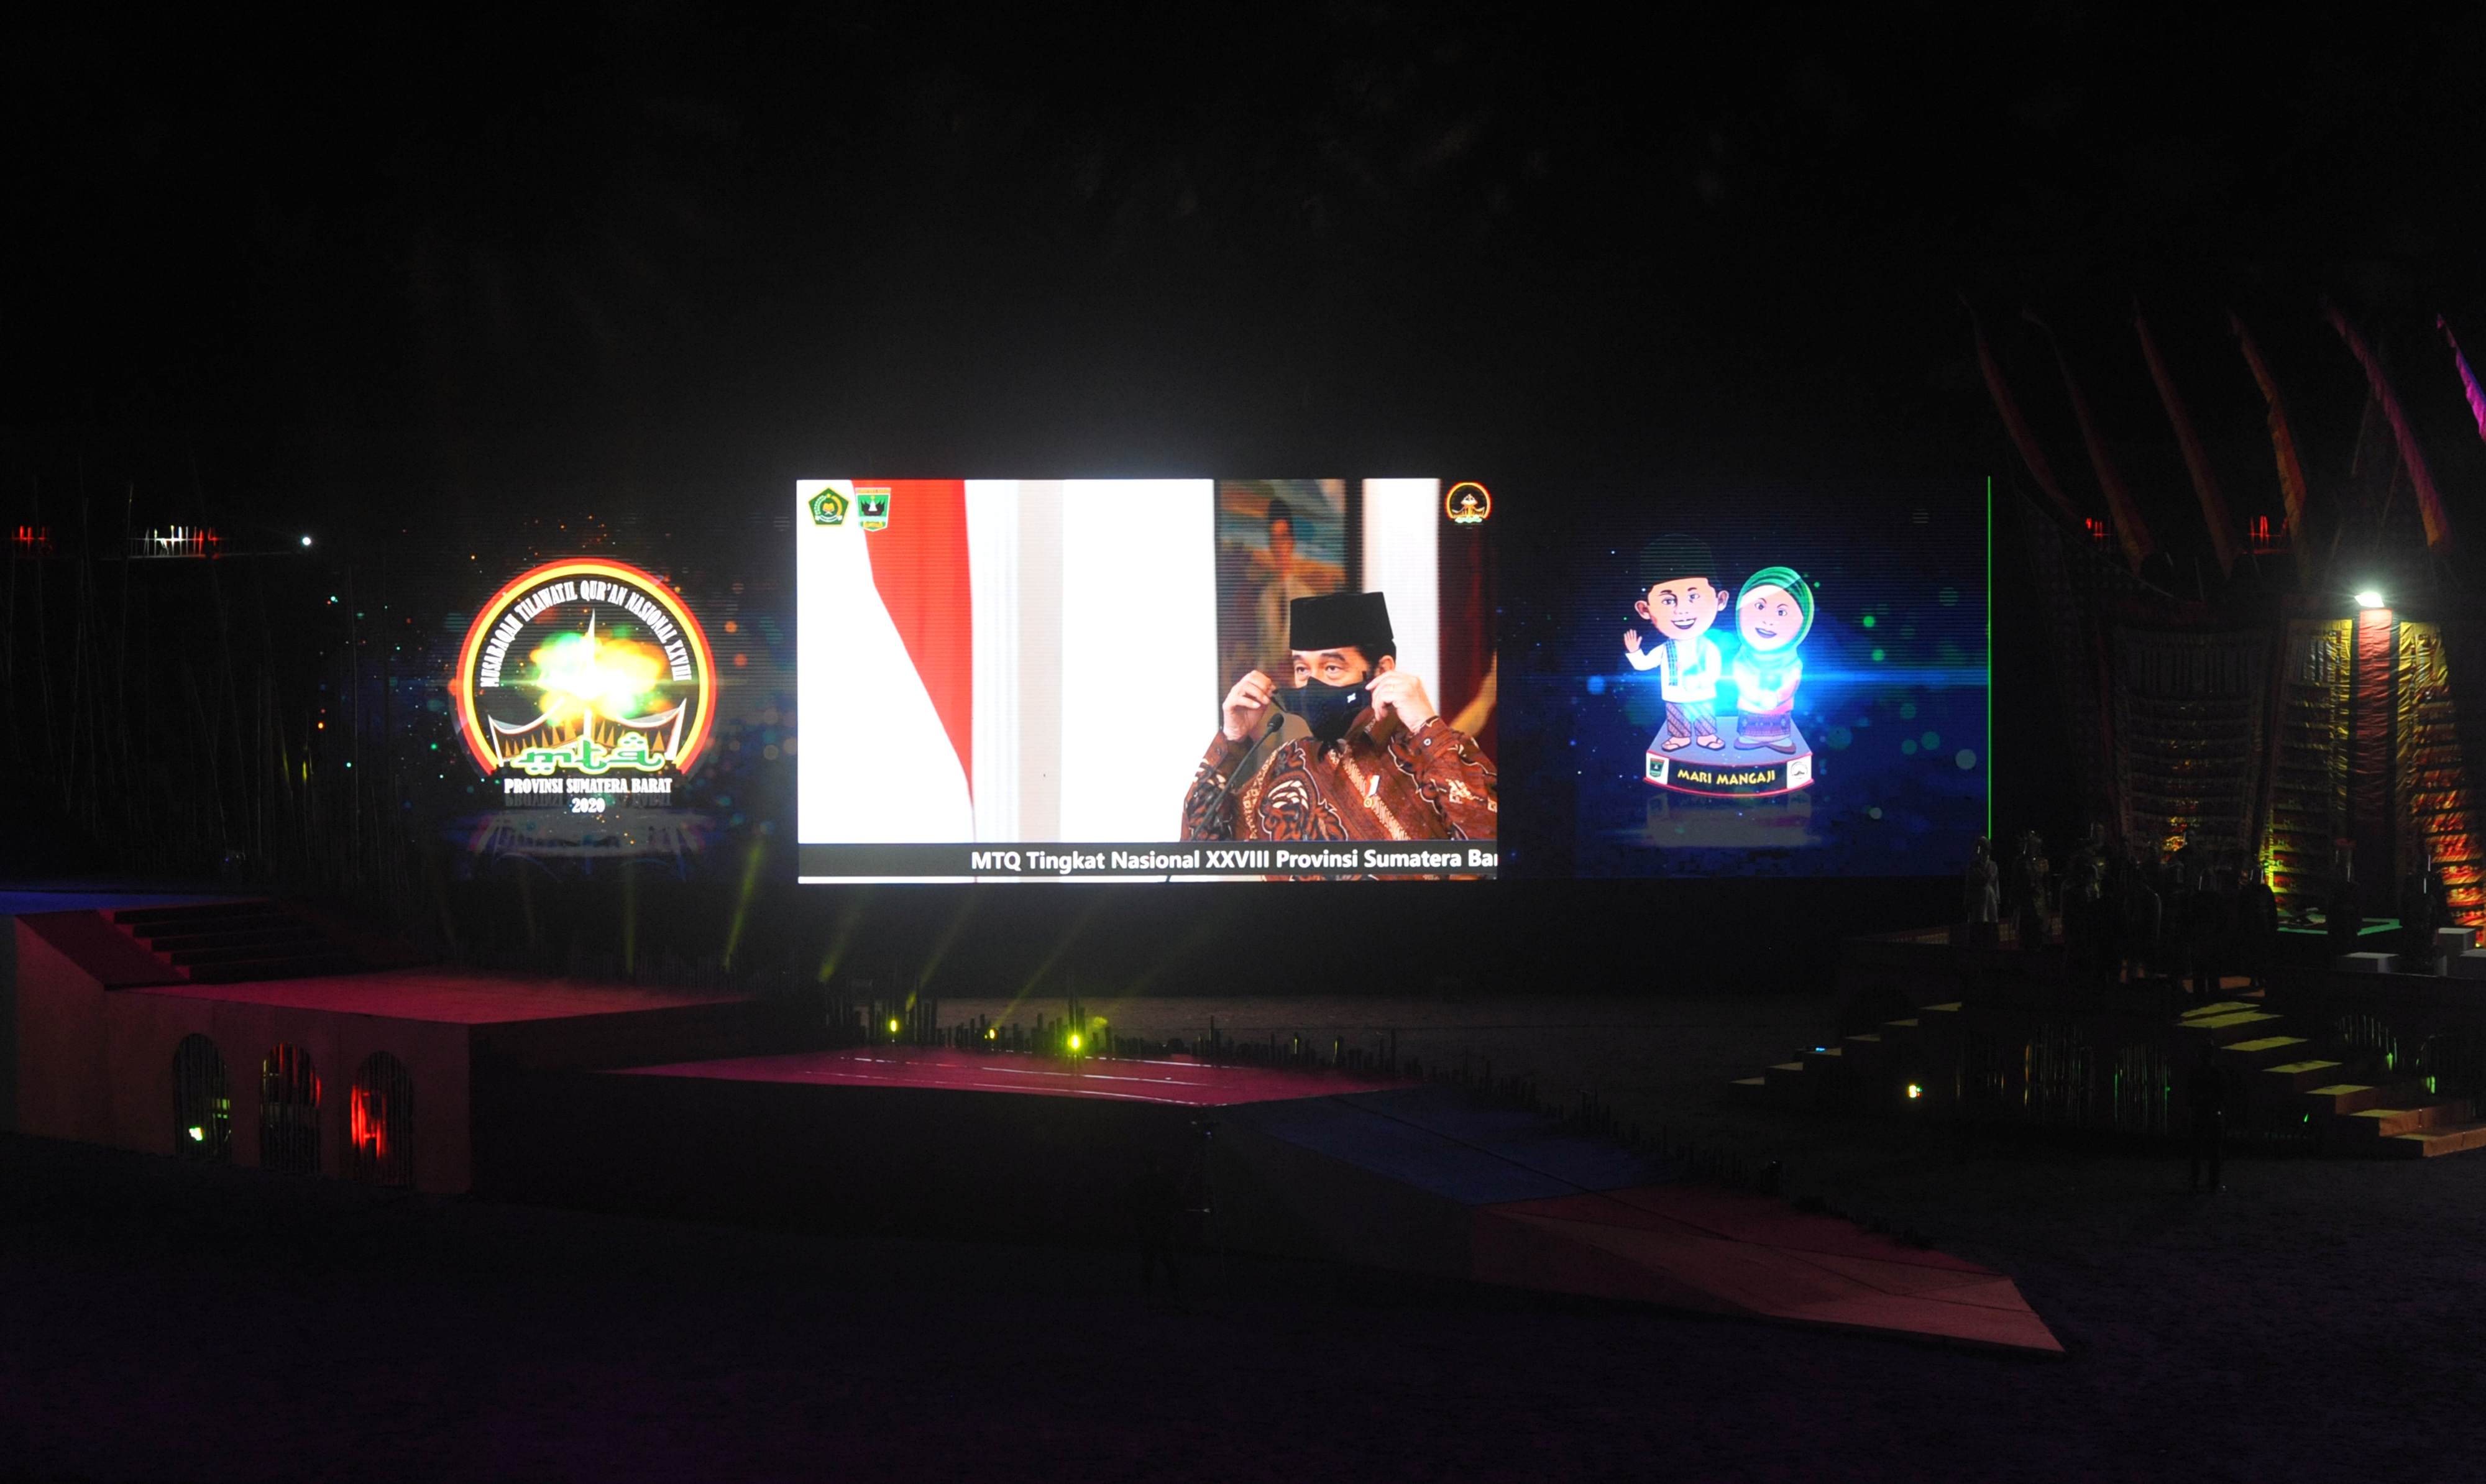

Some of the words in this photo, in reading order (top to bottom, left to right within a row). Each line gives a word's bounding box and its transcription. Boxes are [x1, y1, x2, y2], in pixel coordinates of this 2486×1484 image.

[480, 613, 524, 688] MUSABAQAH
[513, 580, 578, 622] TILAWATIL
[580, 579, 628, 607] QUR'AN
[624, 591, 678, 644] NASIONAL
[664, 638, 692, 682] XXVIII
[503, 777, 564, 794] PROVINSI
[566, 777, 630, 794] SUMATERA
[631, 777, 673, 794] BARAT
[1677, 769, 1712, 784] MARI
[1715, 769, 1776, 785] MANGAJI
[571, 797, 606, 813] 2020
[971, 851, 1022, 871] MTQ
[1025, 850, 1106, 874] Tingkat
[1111, 850, 1201, 869] Nasional
[1205, 850, 1270, 869] XXVIII
[1276, 848, 1359, 868] Provinsi
[1364, 849, 1462, 868] Sumatera
